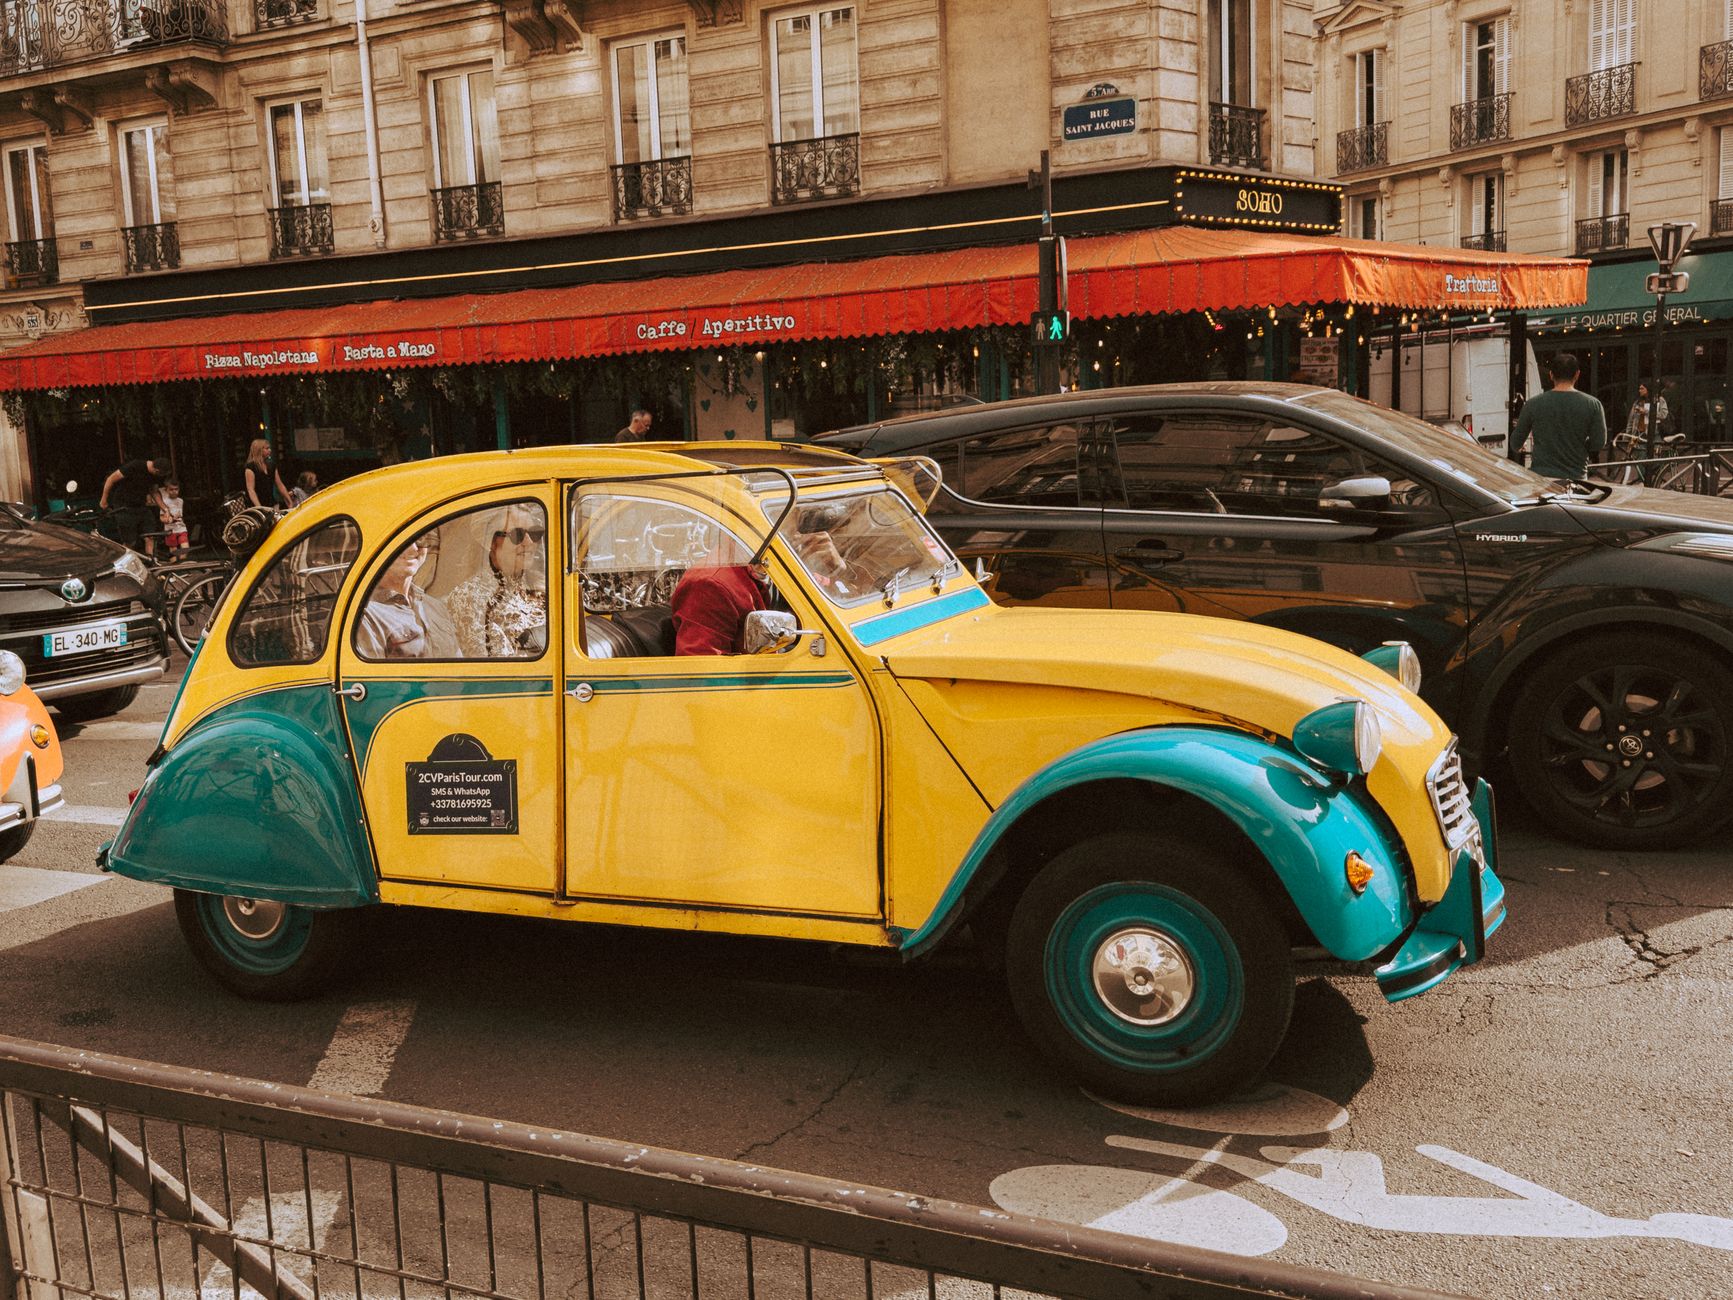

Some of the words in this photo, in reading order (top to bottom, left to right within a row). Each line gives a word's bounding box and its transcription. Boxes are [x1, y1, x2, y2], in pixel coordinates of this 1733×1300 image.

[1089, 108, 1109, 119] RUE
[1065, 124, 1092, 135] SAINT
[1094, 118, 1134, 130] JACQUES
[1236, 189, 1283, 214] SOHO
[1445, 274, 1498, 293] Trattoria
[636, 321, 686, 339] Caffe
[702, 314, 795, 338] Aperitivo
[1564, 316, 1577, 329] LE
[1581, 311, 1638, 328] QUARTIER
[204, 354, 242, 369] Pizza
[243, 349, 319, 369] Napoletana
[343, 344, 385, 361] Pasta
[386, 346, 397, 358] a
[398, 341, 435, 357] Mano
[1475, 534, 1519, 542] HYBRID
[418, 772, 503, 783] 2CVParisTour.com
[431, 788, 447, 796] SMS
[447, 787, 453, 795] &
[454, 787, 491, 796] WhatsApp
[430, 798, 492, 808] +33781695925
[433, 815, 451, 823] check
